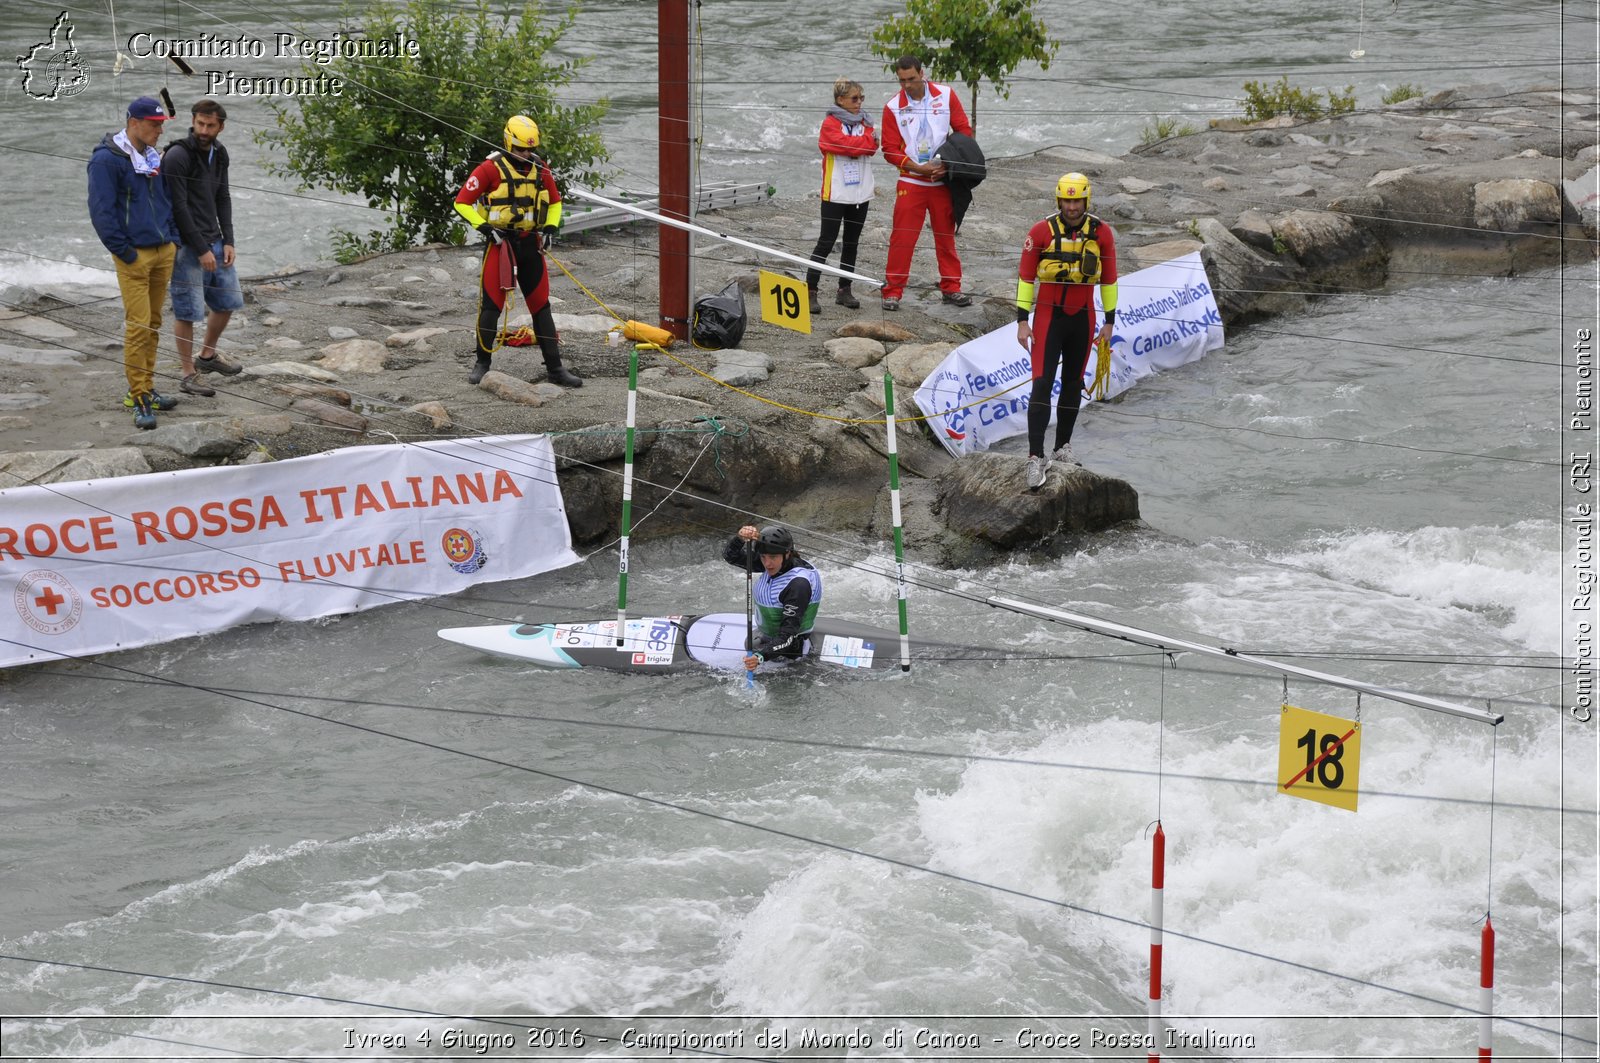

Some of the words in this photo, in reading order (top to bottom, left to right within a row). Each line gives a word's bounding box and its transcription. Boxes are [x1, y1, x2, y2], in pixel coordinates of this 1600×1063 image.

[769, 284, 801, 320] 19
[1117, 297, 1178, 328] Federazione
[1132, 328, 1180, 355] Canoa
[978, 392, 1032, 426] Can
[131, 495, 288, 547] ROSSA
[299, 469, 523, 525] ITALIANA
[89, 566, 261, 609] SOCCORSO
[278, 540, 426, 583] FLUVIALE
[568, 625, 583, 645] SLO
[647, 655, 671, 664] triglav
[1297, 728, 1344, 789] 18
